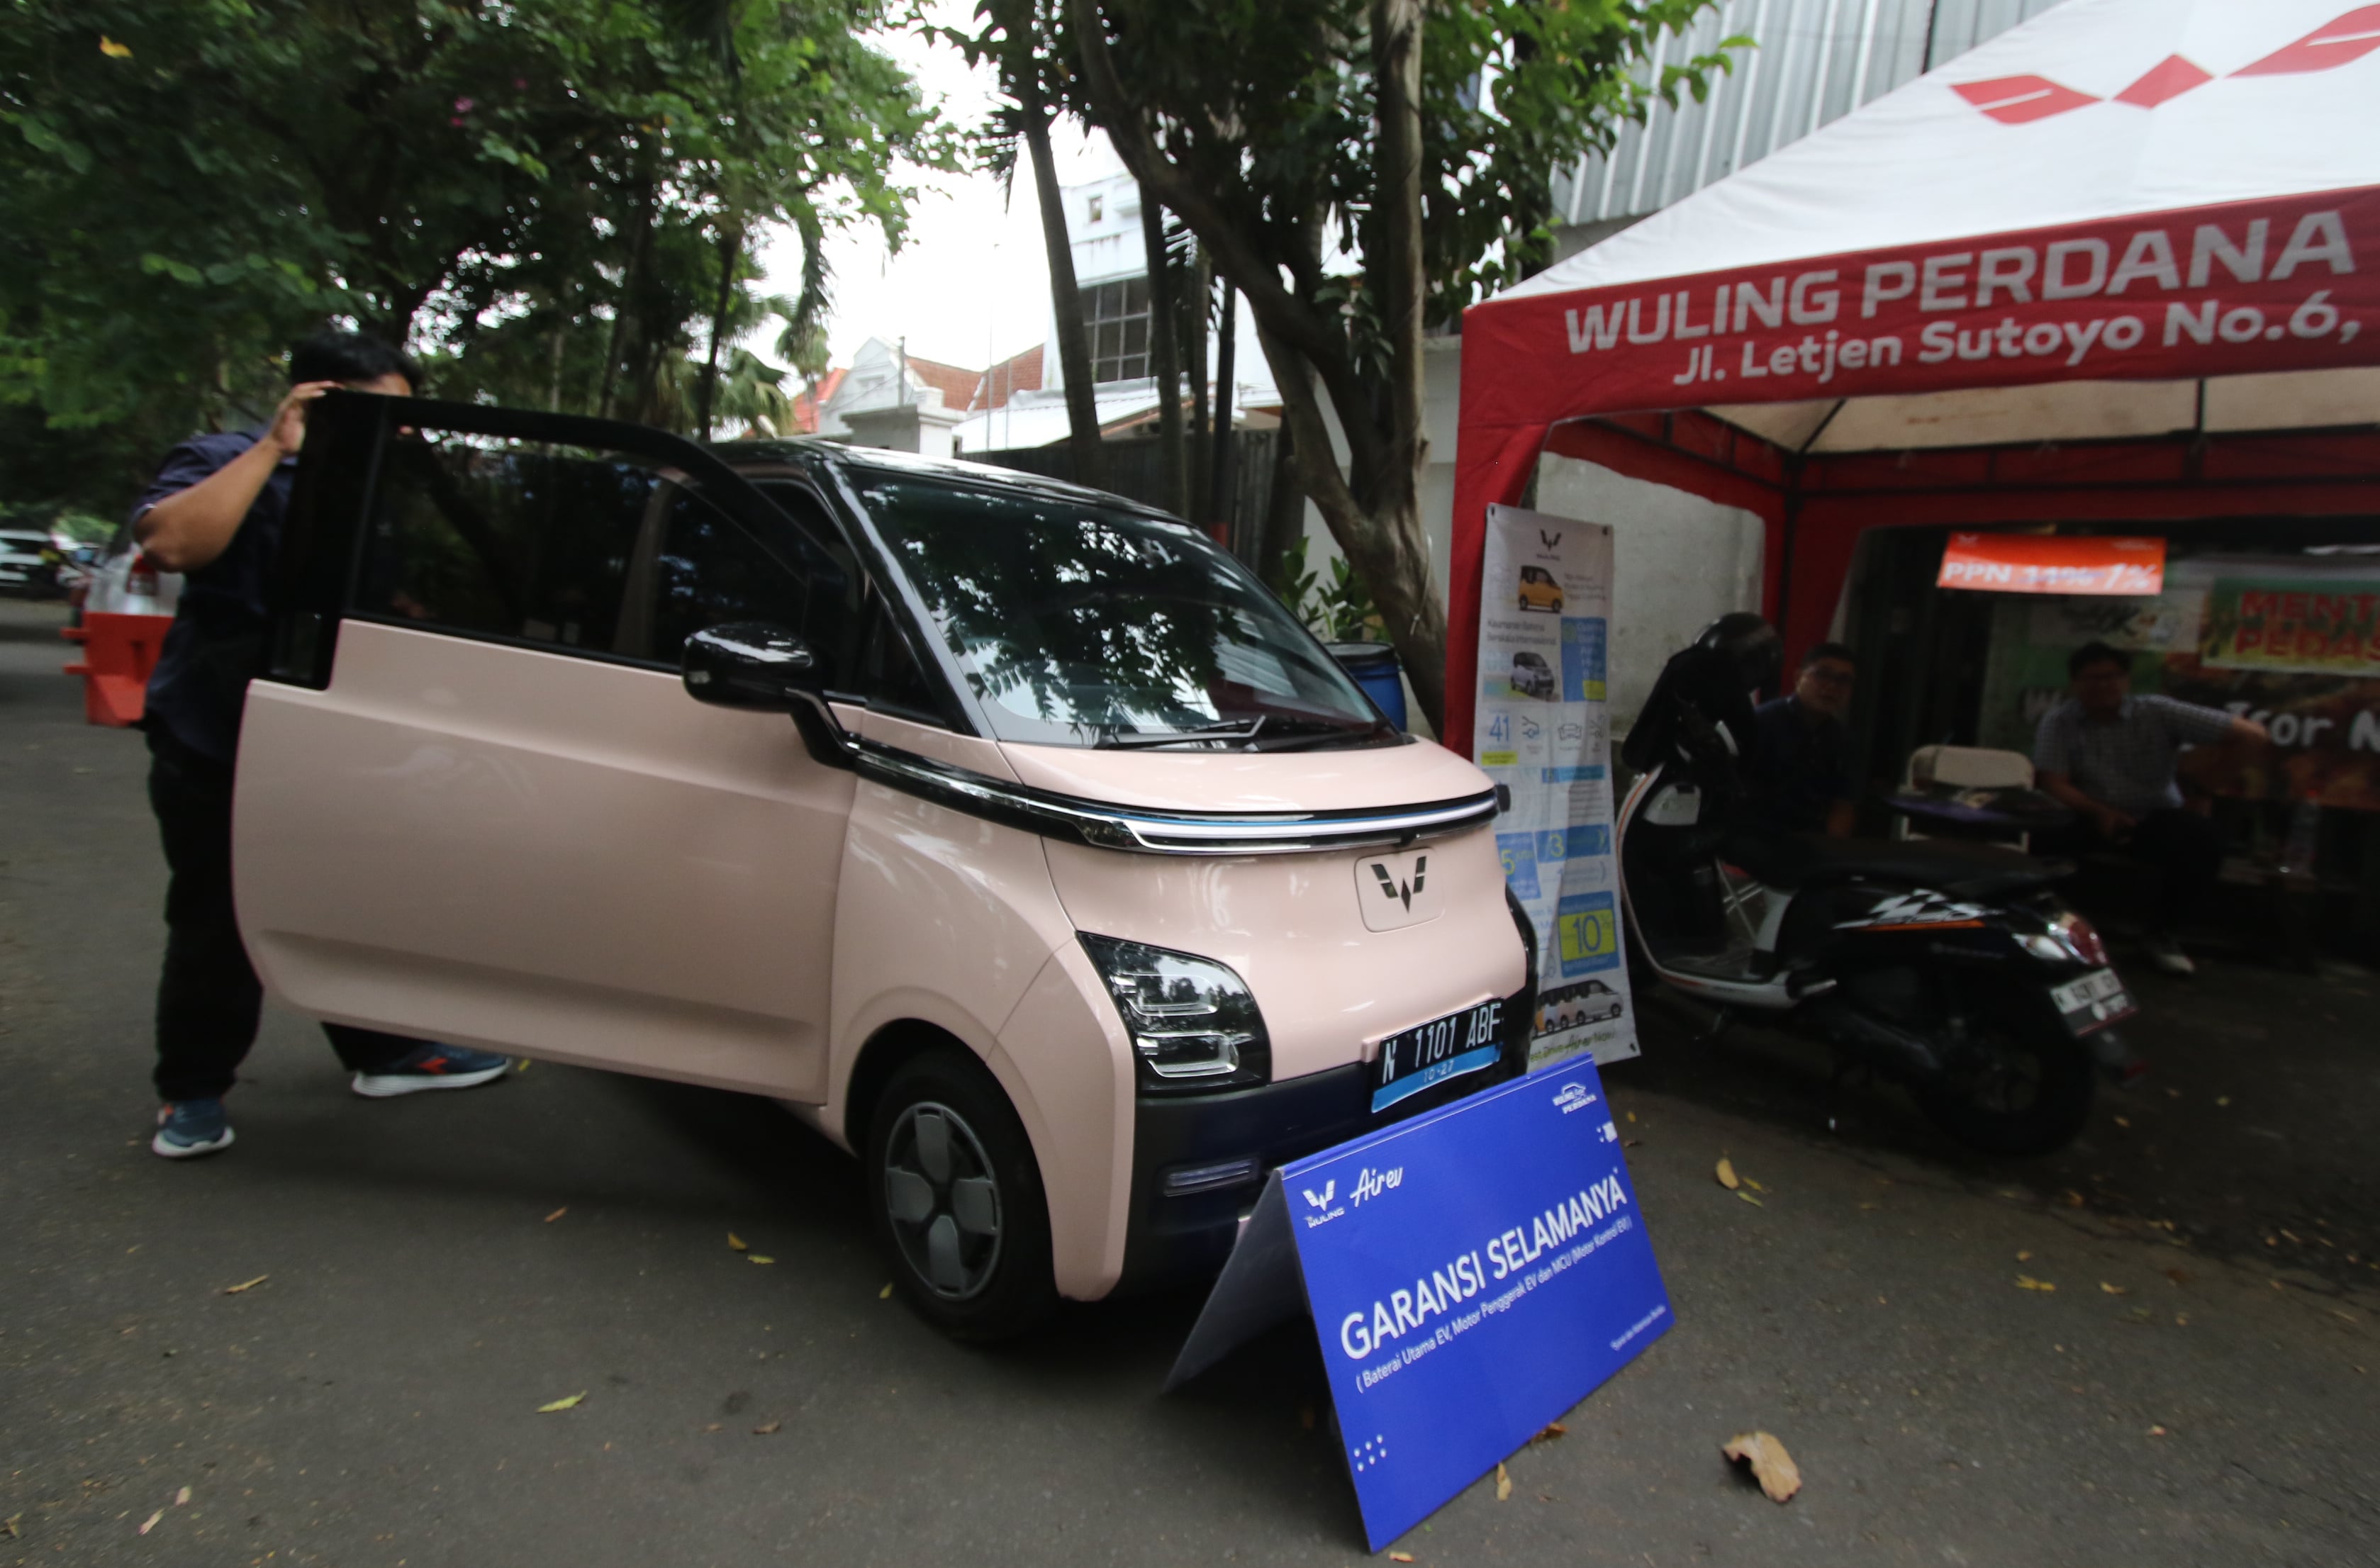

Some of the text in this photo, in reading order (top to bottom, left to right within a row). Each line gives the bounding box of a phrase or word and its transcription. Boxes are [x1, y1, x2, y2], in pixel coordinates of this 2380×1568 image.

[1565, 211, 2356, 354] WULING PERDANA
[1673, 290, 2362, 386] Jl. Letjen Sutoyo No.6,
[1943, 561, 2012, 583] PPN
[2104, 562, 2157, 590] 1%
[1490, 715, 1509, 742] 41
[1501, 848, 1516, 875] 5
[1551, 833, 1565, 858] 3
[1572, 914, 1602, 953] 10
[1382, 1040, 1397, 1085] N
[1415, 1017, 1457, 1068] 1101
[1341, 1250, 1485, 1360] GARANSI
[1487, 1172, 1628, 1280] SELAMANYA
[1362, 1352, 1402, 1388] Baterai
[1401, 1337, 1436, 1365] Utama
[1435, 1324, 1454, 1347] EV,
[1452, 1309, 1482, 1338] Motor
[1480, 1282, 1527, 1319] Penggerak
[1524, 1271, 1537, 1292] EV
[1537, 1265, 1553, 1284] dan
[1551, 1253, 1572, 1275] MCU
